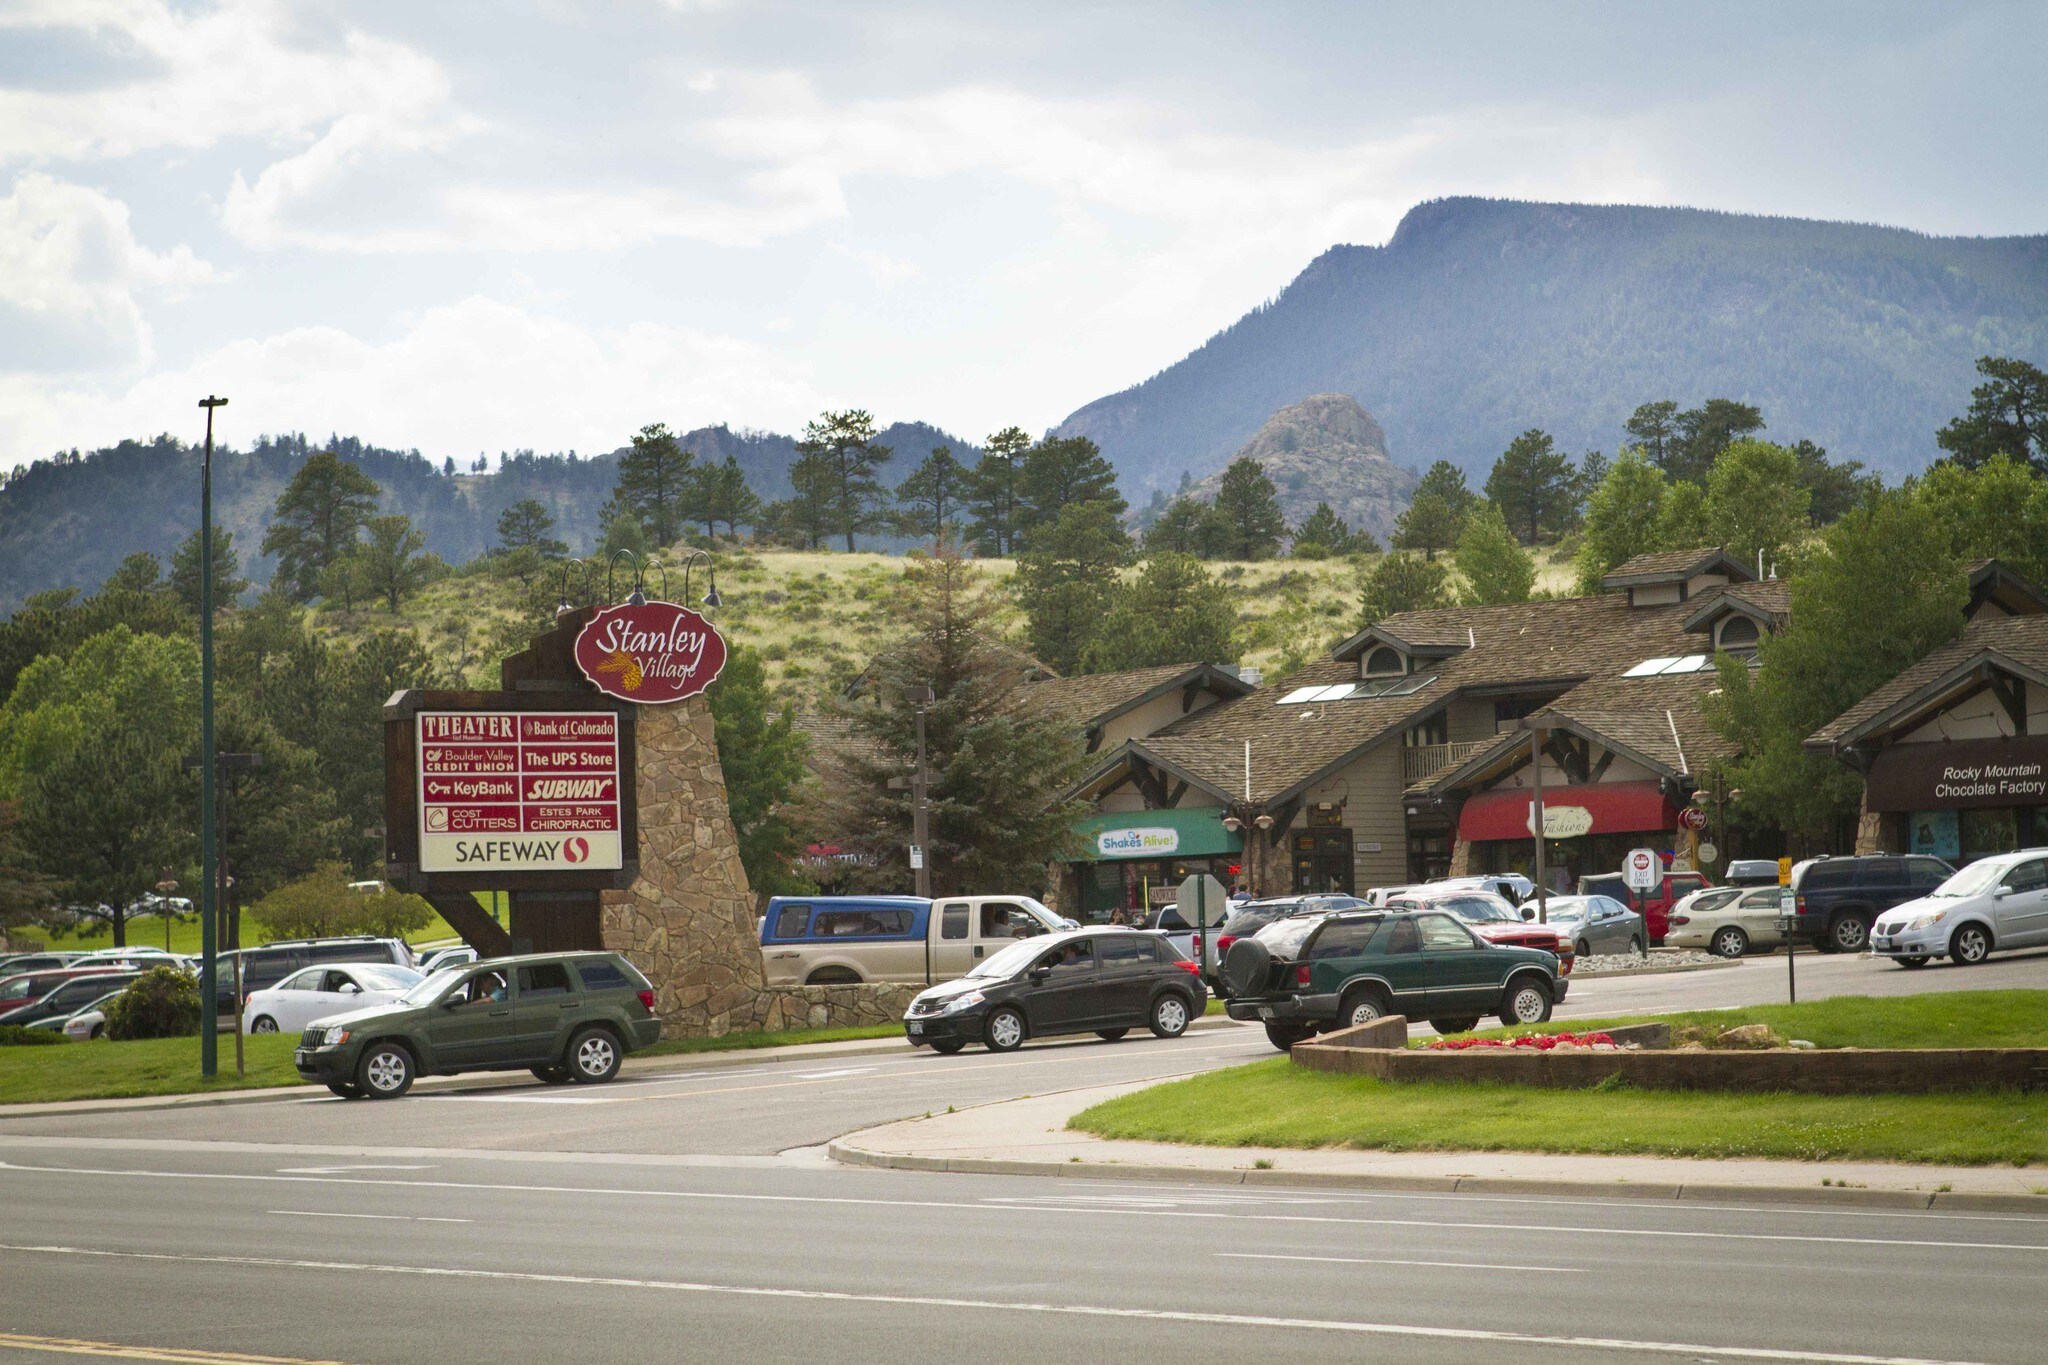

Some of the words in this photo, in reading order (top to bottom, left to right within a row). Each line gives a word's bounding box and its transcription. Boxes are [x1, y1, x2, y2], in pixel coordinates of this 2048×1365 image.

[596, 613, 706, 672] Stanley
[634, 653, 697, 690] Village
[425, 717, 514, 737] THEATER
[534, 721, 558, 735] Bank
[559, 720, 569, 735] of
[570, 720, 614, 735] Colorado
[445, 749, 484, 761] Boulder
[485, 749, 514, 763] Valley
[525, 752, 549, 766] The
[552, 752, 578, 766] UPS
[580, 752, 613, 766] Store
[426, 762, 470, 771] CREDIT
[475, 762, 514, 771] UNION
[1943, 766, 1982, 781] Rocky
[1984, 763, 2041, 778] Mountain
[453, 781, 514, 798] KeyBank
[527, 778, 614, 800] SUBWAY
[1935, 782, 1996, 798] Chocolate
[1999, 780, 2046, 796] Factory
[452, 809, 482, 818] COST
[540, 807, 572, 816] ESTES
[576, 807, 602, 816] PARK
[452, 818, 517, 829] CUTTERS
[530, 819, 612, 830] CHIROPRACTIC
[1103, 836, 1142, 849] Shakes
[1143, 834, 1174, 847] Alive!
[456, 841, 560, 862] SAFEWAY
[1150, 887, 1177, 901] SANDWICHE
